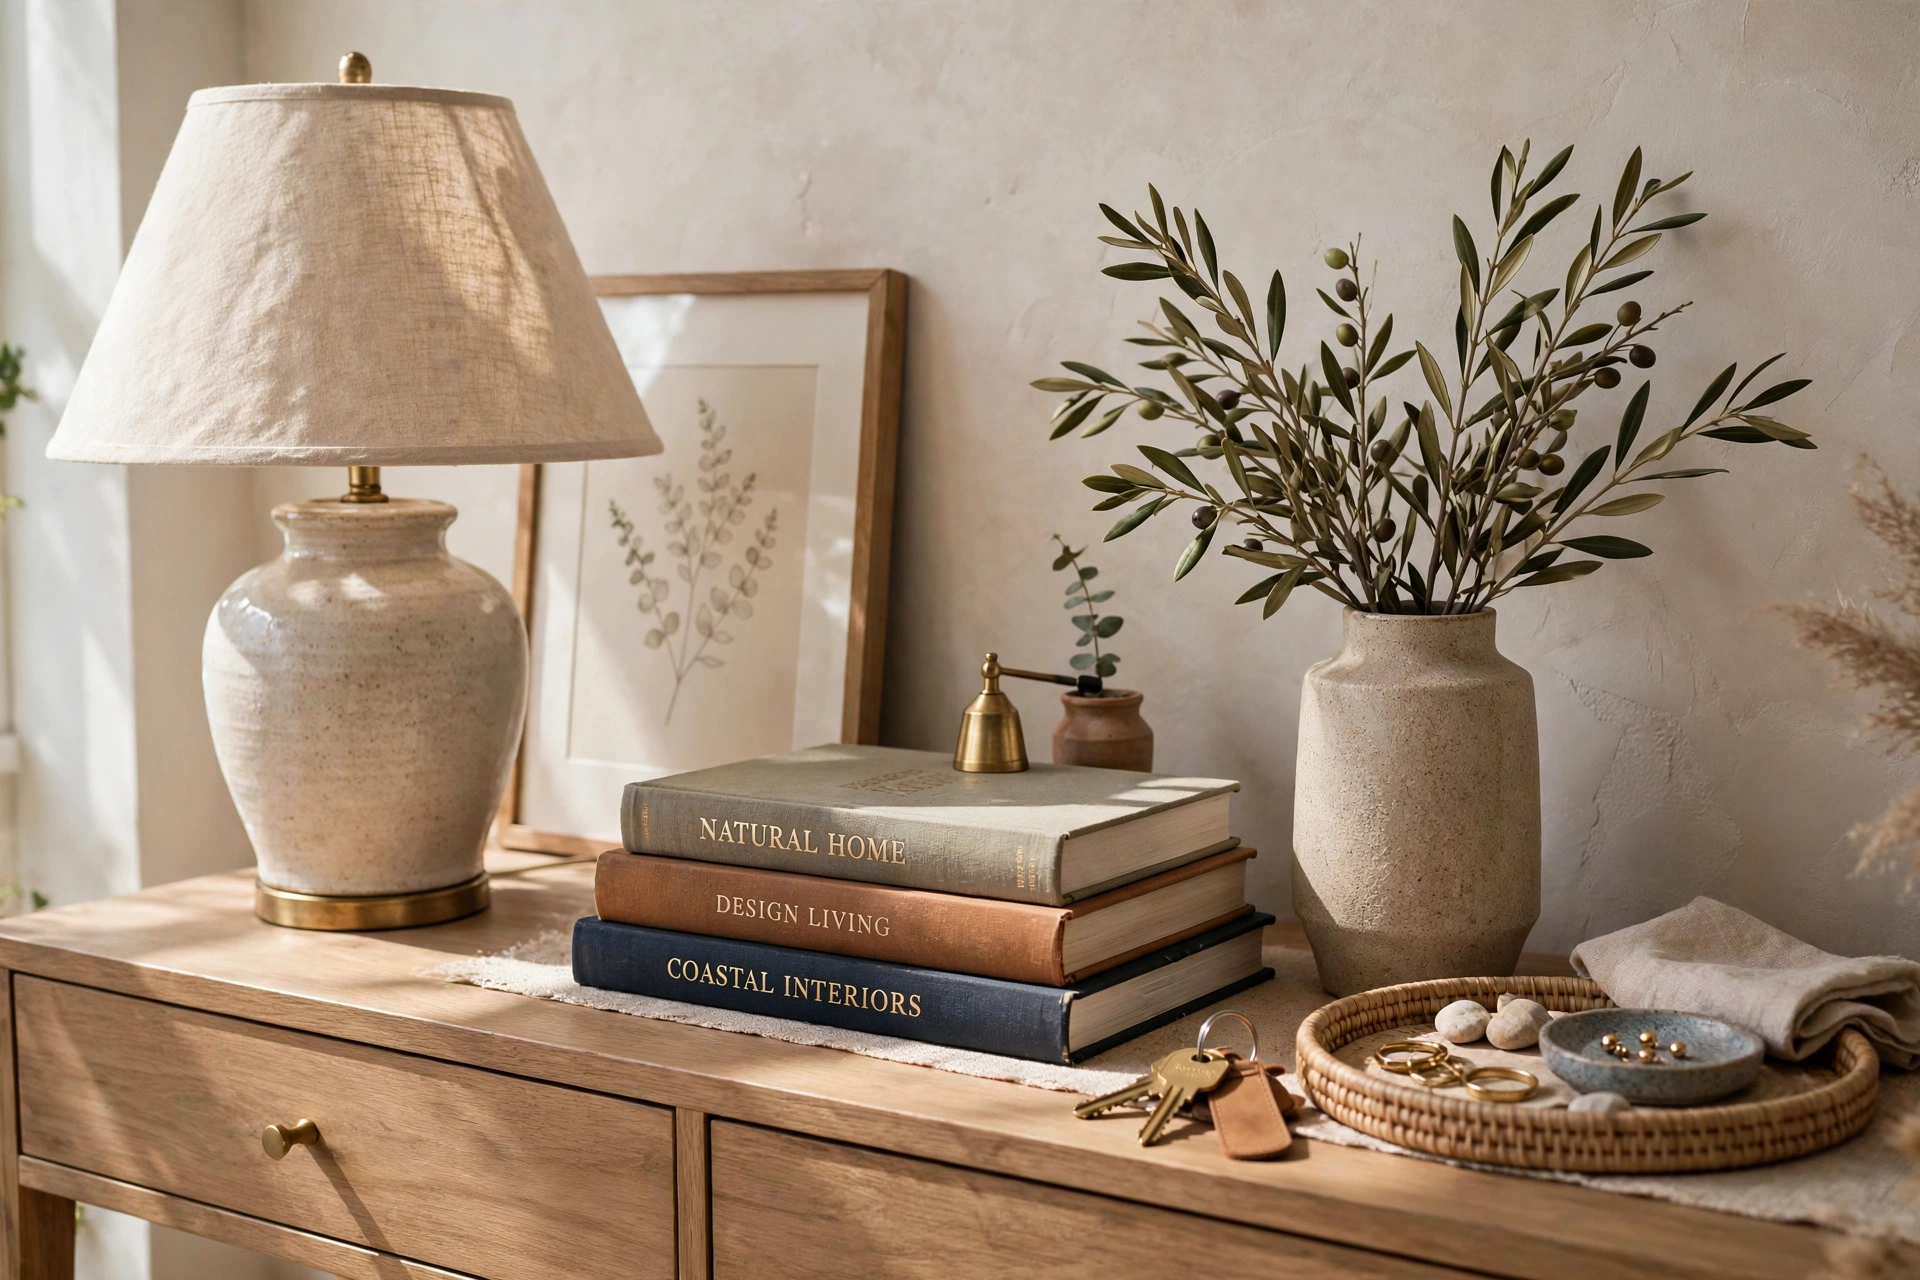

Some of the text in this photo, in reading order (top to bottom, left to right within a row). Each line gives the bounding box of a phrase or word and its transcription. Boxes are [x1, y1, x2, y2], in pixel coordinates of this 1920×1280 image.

[699, 817, 906, 865] NATURAL HOME
[716, 895, 890, 937] DESIGN LIVING
[667, 957, 922, 1017] COASTAL INTERIORS
